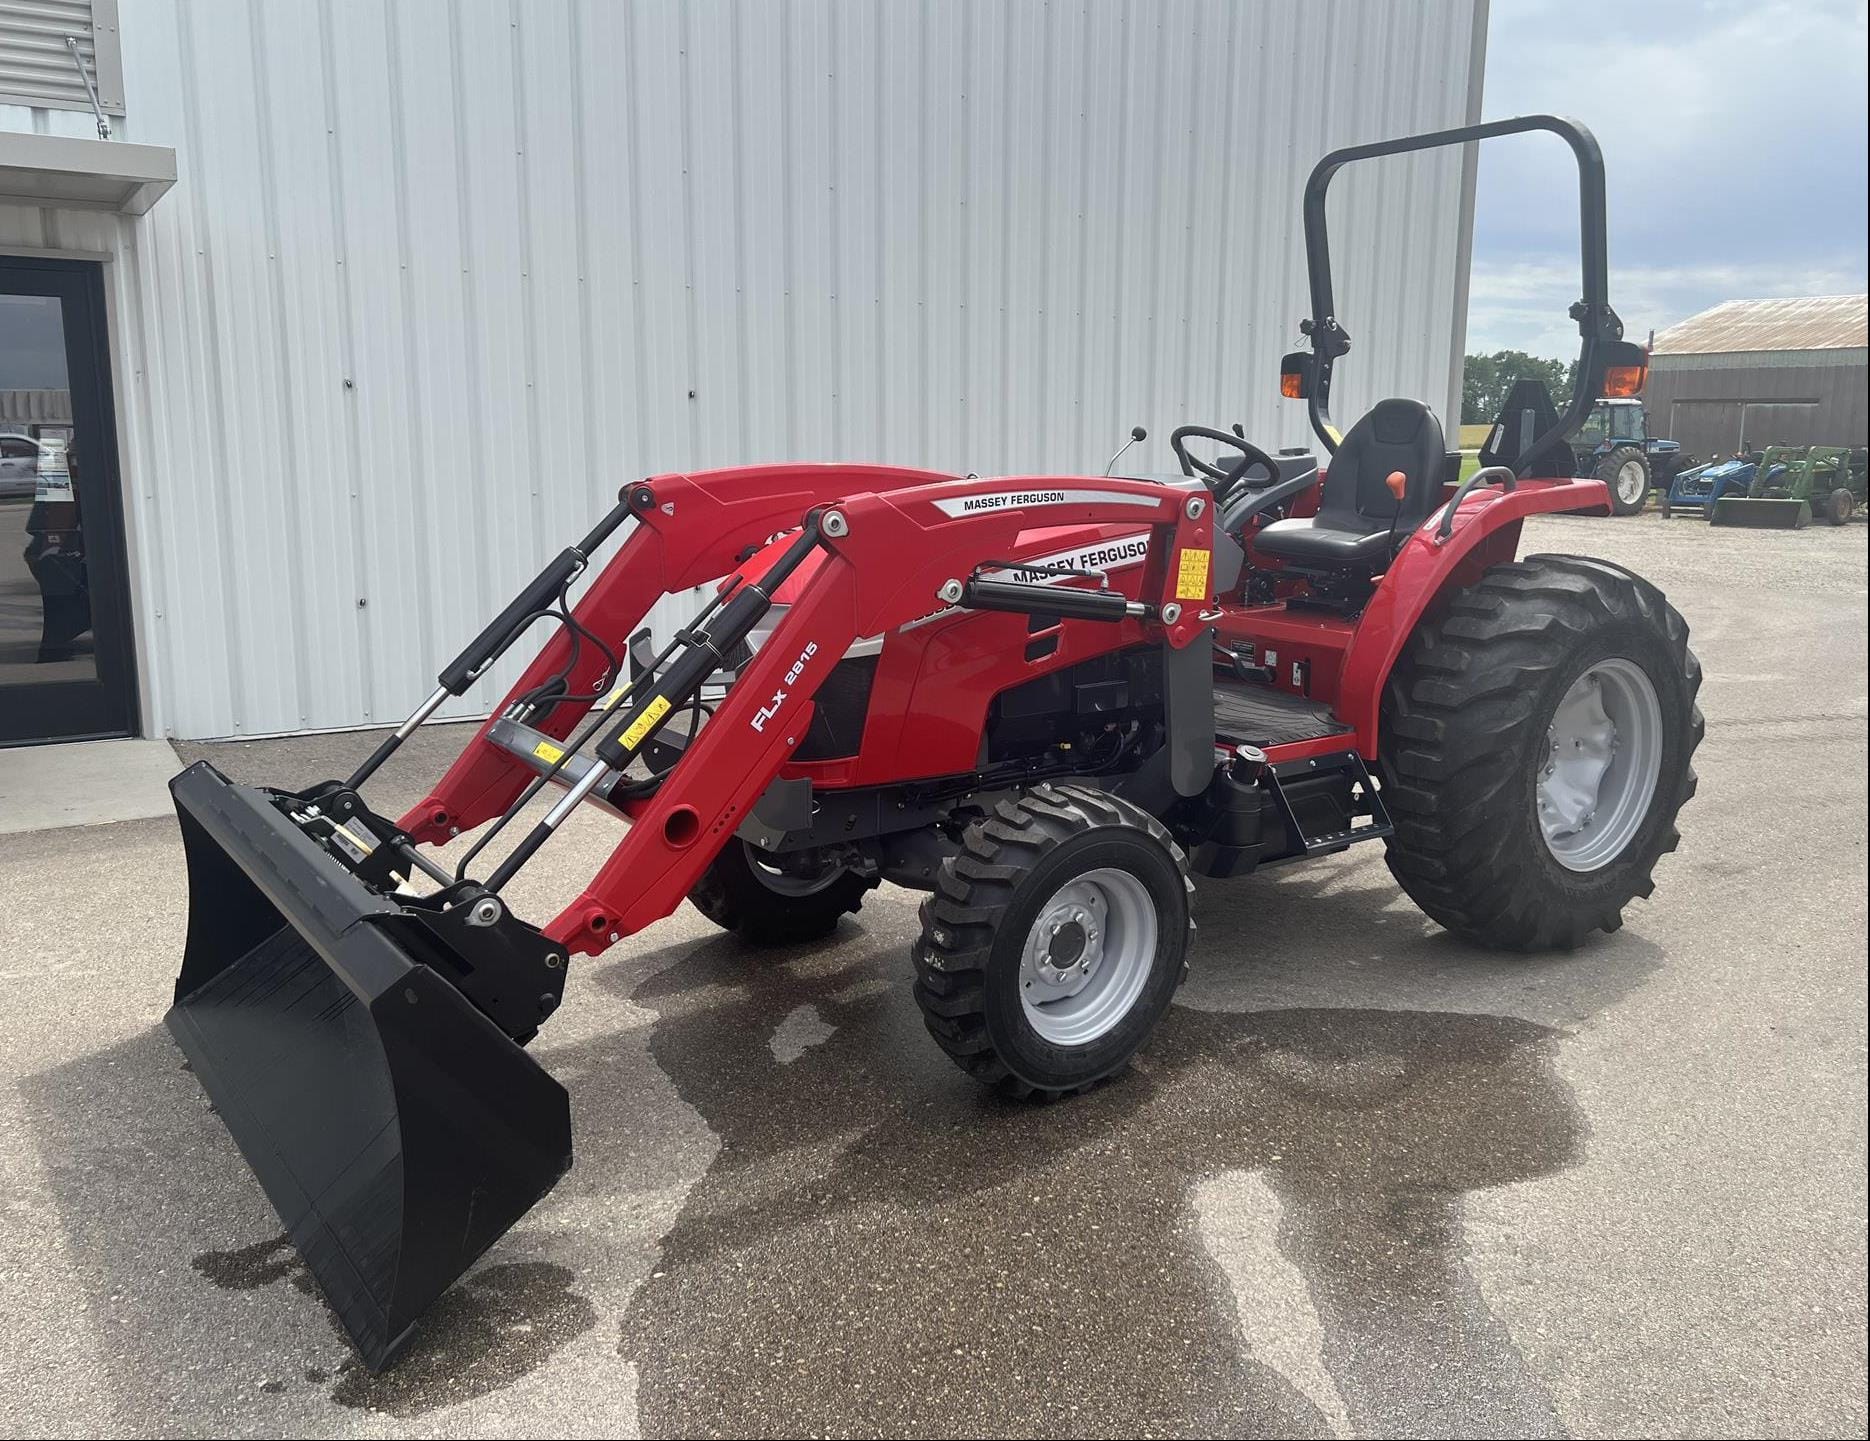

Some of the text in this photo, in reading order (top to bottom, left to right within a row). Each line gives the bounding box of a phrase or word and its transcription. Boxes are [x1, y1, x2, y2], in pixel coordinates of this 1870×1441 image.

[964, 492, 1064, 511] MASSEY FERGUSON
[1080, 541, 1149, 569] FERGUSO
[750, 641, 818, 733] FLX 2815
